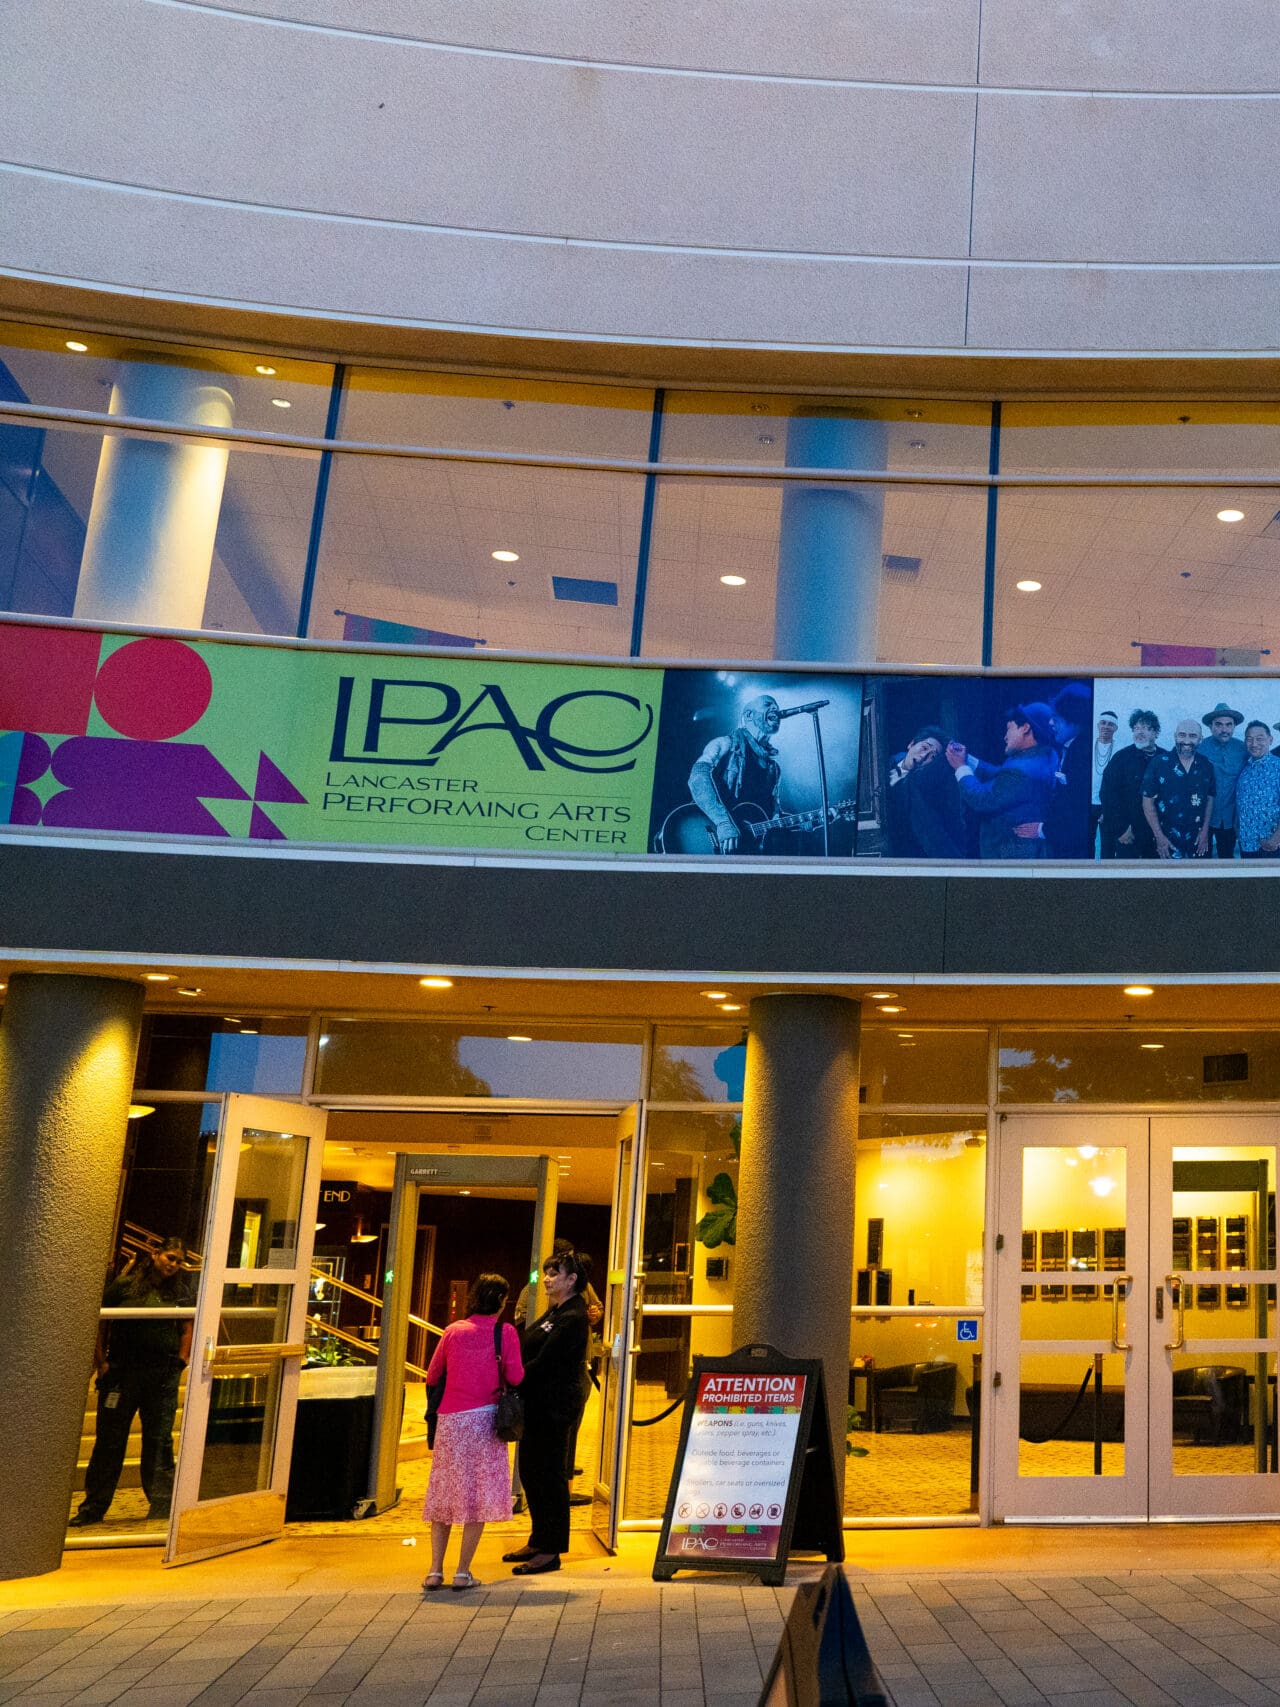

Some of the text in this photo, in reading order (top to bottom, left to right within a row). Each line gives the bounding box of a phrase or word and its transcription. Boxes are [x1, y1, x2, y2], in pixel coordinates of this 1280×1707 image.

[329, 676, 654, 774] LPAC
[325, 771, 479, 793] LANCASTER
[322, 792, 631, 823] PERFORMING ARTS
[525, 825, 627, 844] CENTER
[324, 1190, 351, 1202] END
[704, 1377, 796, 1392] ATTENTION
[702, 1393, 795, 1403] PROHIBITED ITEMS
[716, 1430, 740, 1438] pepper
[737, 1449, 772, 1458] beverages
[682, 1537, 719, 1550] LPAC
